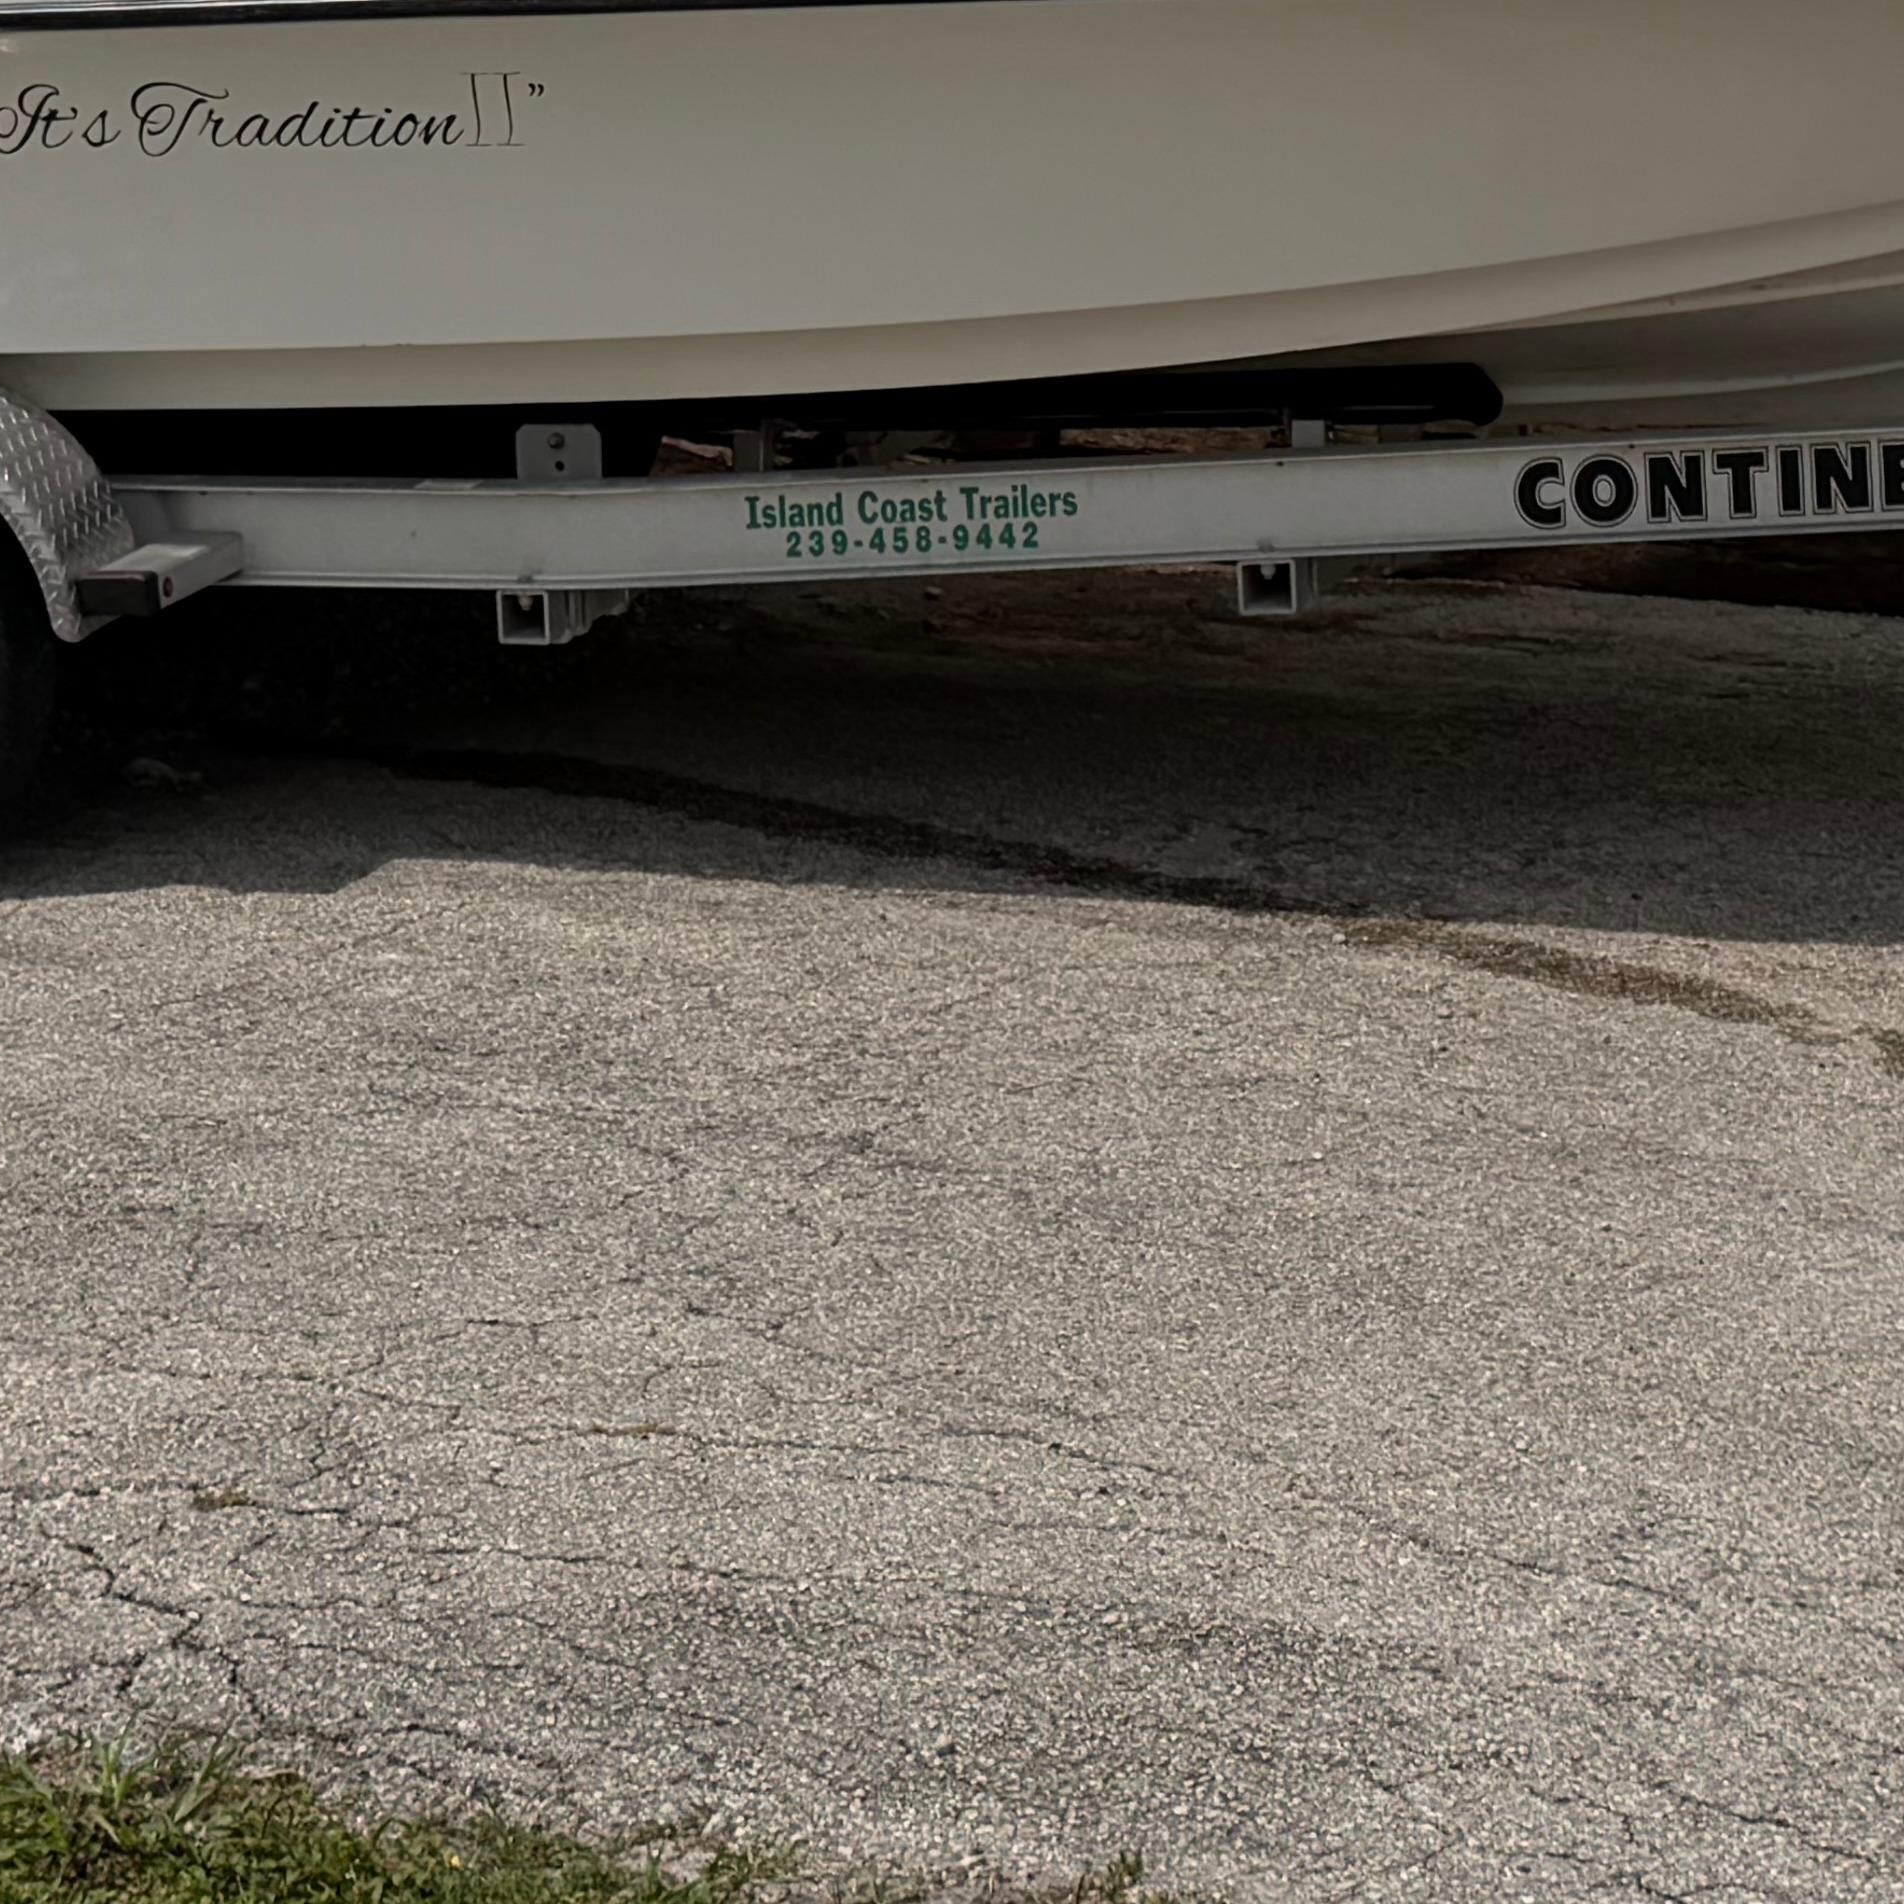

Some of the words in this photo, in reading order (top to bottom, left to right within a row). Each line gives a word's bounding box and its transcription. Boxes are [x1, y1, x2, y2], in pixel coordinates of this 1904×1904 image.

[745, 492, 844, 530] Island
[857, 489, 948, 525] Coast
[959, 484, 1079, 521] Trailers
[785, 521, 1040, 559] 239-458-9442
